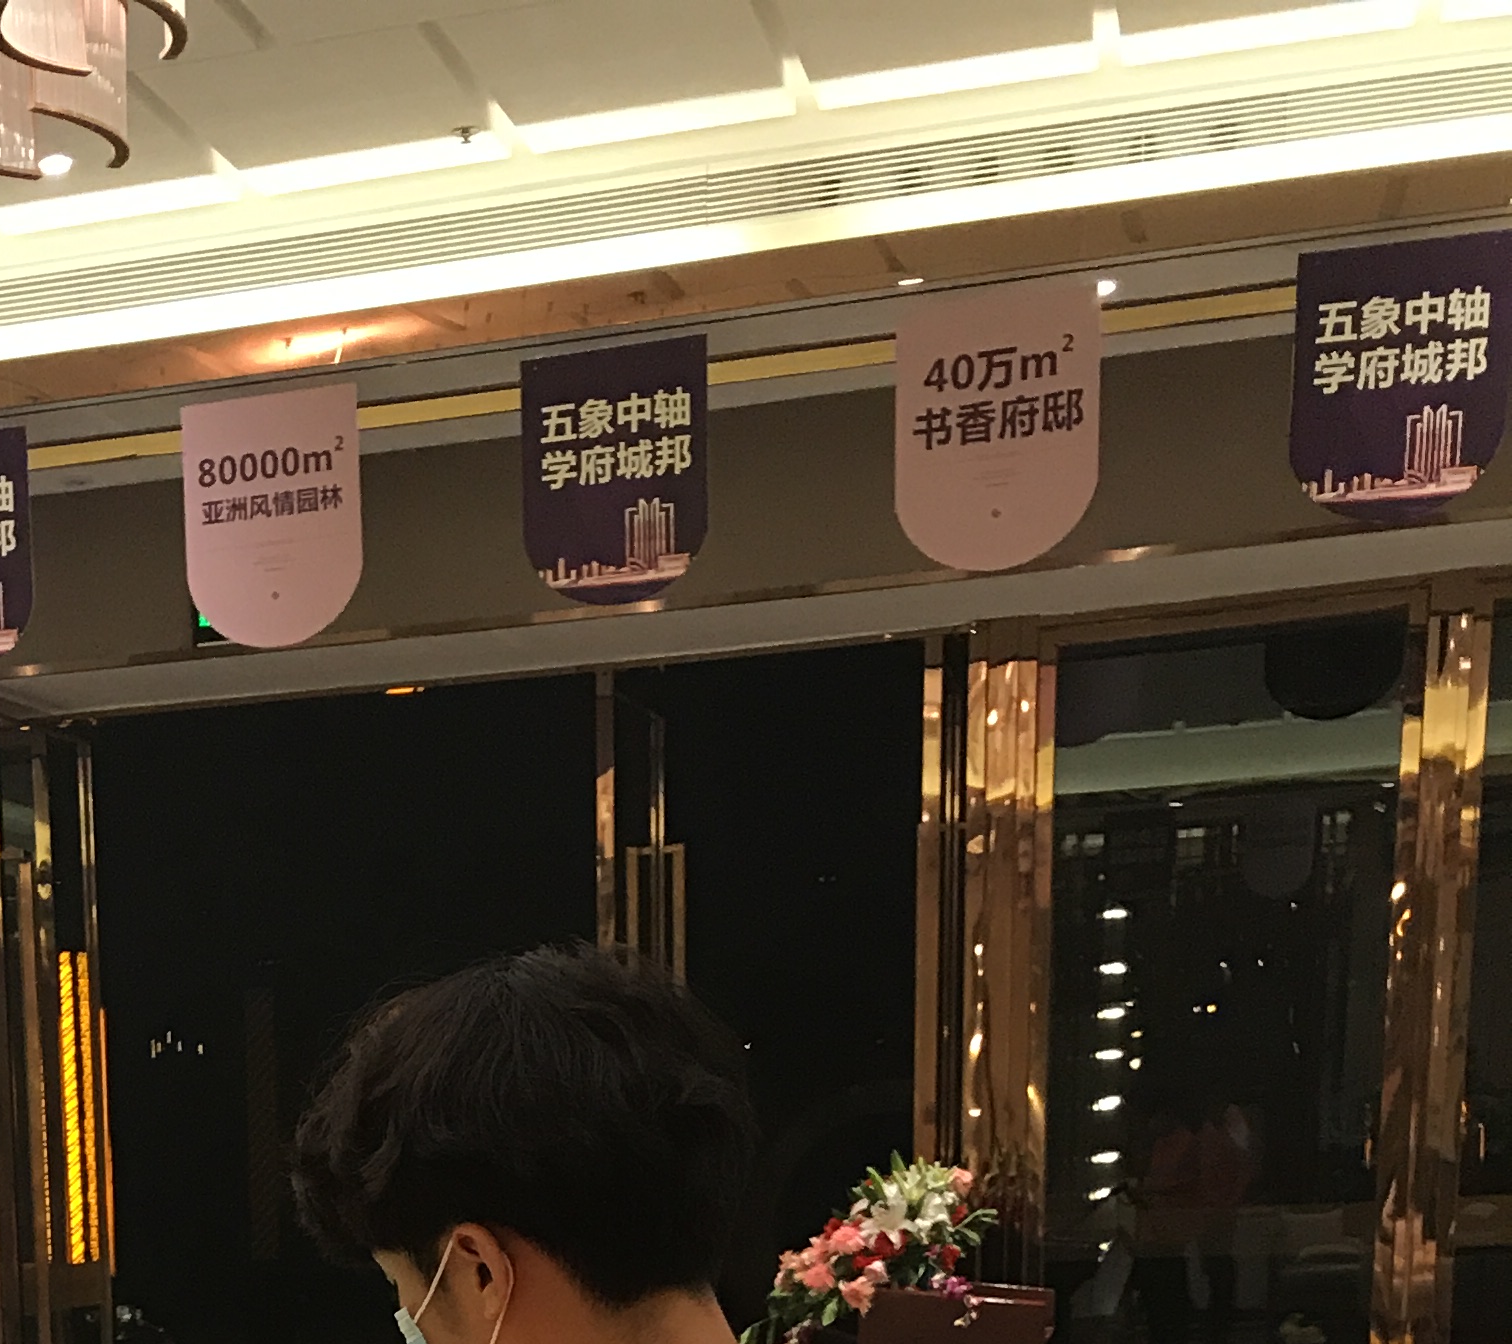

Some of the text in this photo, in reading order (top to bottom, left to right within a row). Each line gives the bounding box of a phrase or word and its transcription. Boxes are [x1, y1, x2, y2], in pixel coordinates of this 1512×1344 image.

[1315, 286, 1491, 345] 五象中轴
[1313, 337, 1487, 396] 学府城邦
[541, 386, 691, 444] 五象中轴
[913, 389, 1084, 450] 书香府邸
[541, 435, 692, 491] 学府城邦
[202, 484, 343, 525] 亚洲风情园林
